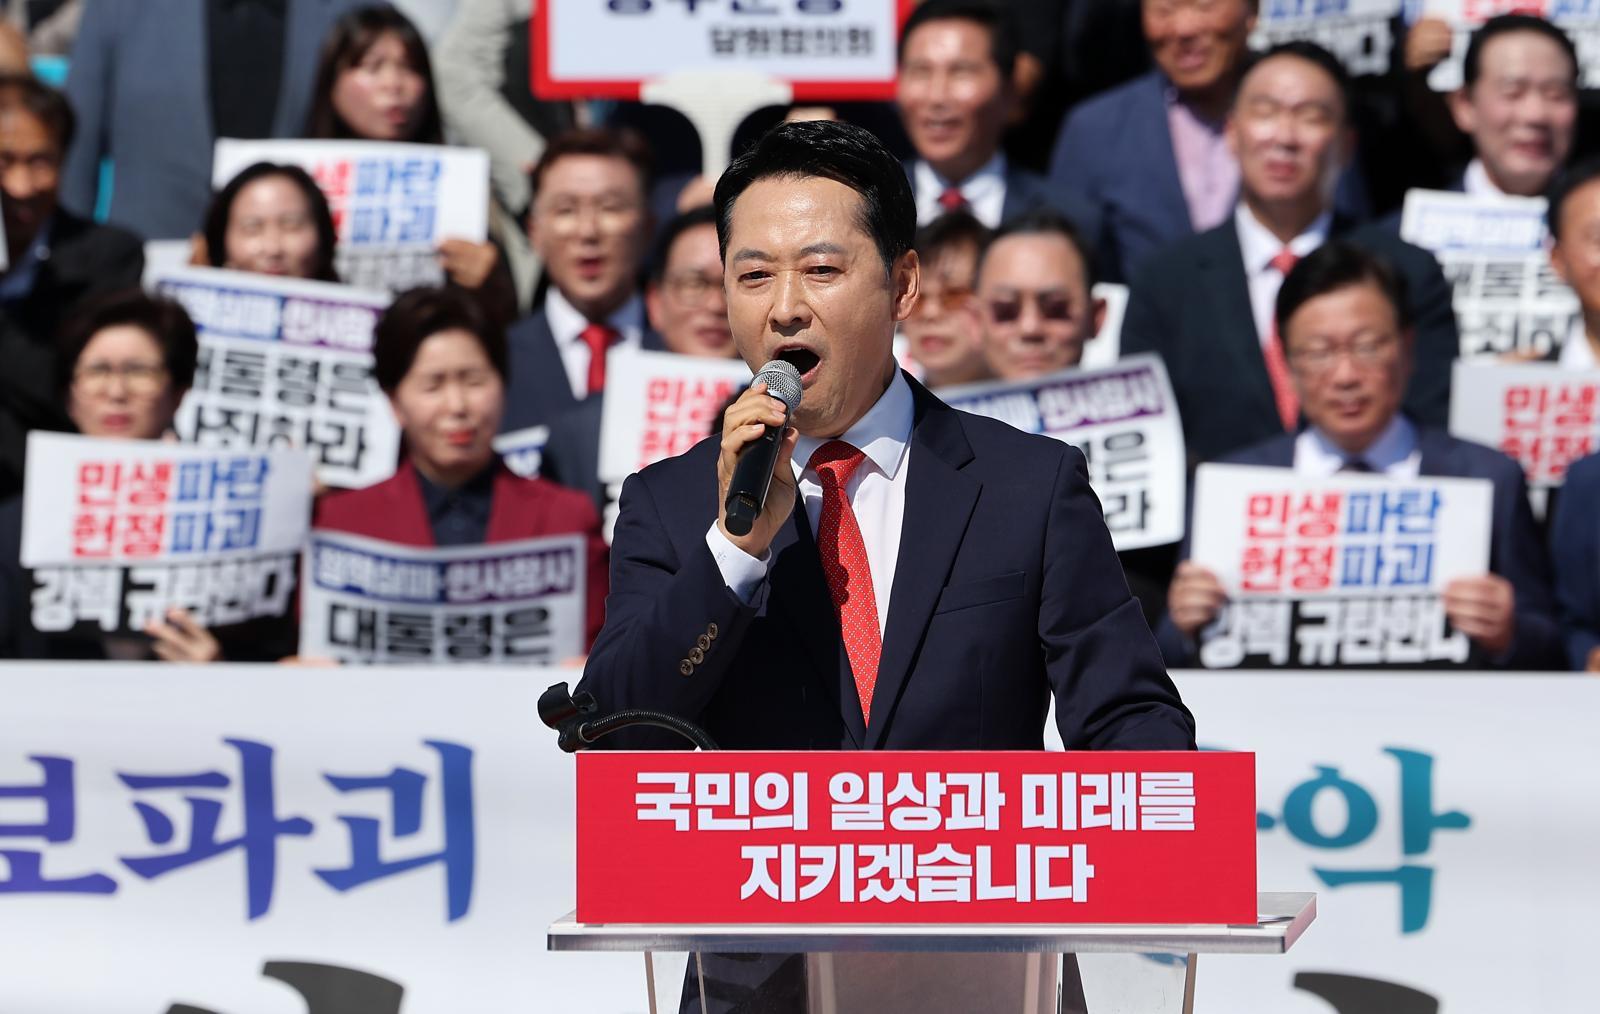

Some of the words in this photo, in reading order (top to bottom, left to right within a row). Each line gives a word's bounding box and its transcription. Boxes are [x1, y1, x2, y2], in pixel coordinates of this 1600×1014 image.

[635, 771, 808, 831] 국민의
[828, 771, 1006, 831] 일상과
[1021, 771, 1196, 831] 미래를
[740, 843, 1095, 903] 지키겠습니다
